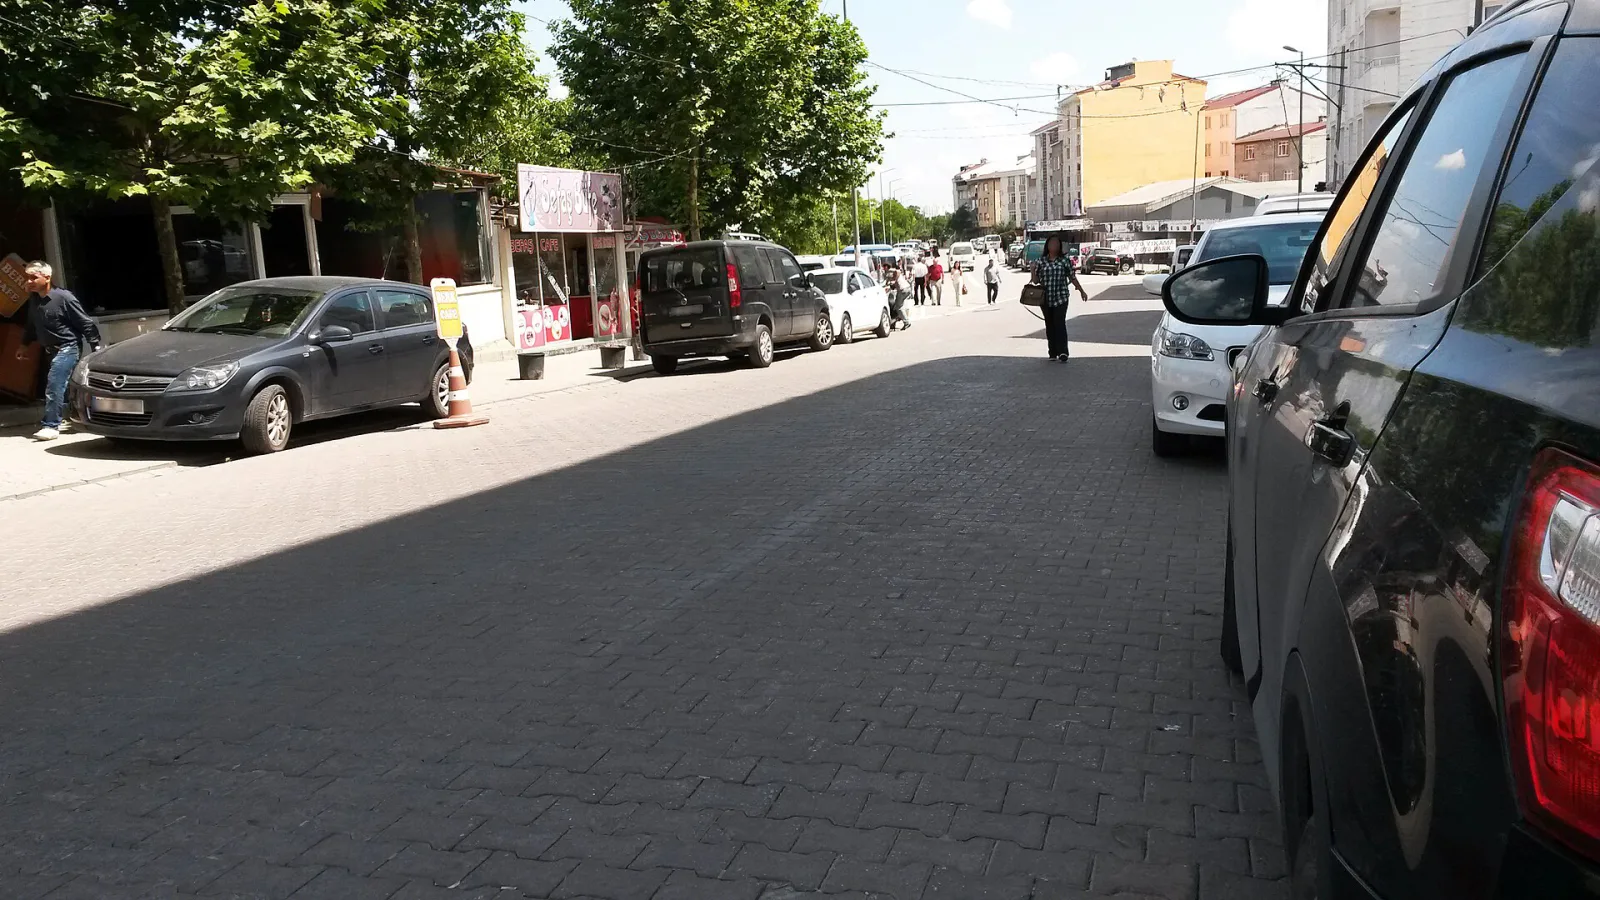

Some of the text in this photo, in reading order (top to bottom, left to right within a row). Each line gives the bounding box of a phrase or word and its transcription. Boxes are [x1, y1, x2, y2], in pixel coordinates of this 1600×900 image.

[541, 175, 573, 227] Sefaş
[540, 238, 559, 252] CAFE
[0, 280, 19, 302] AFE
